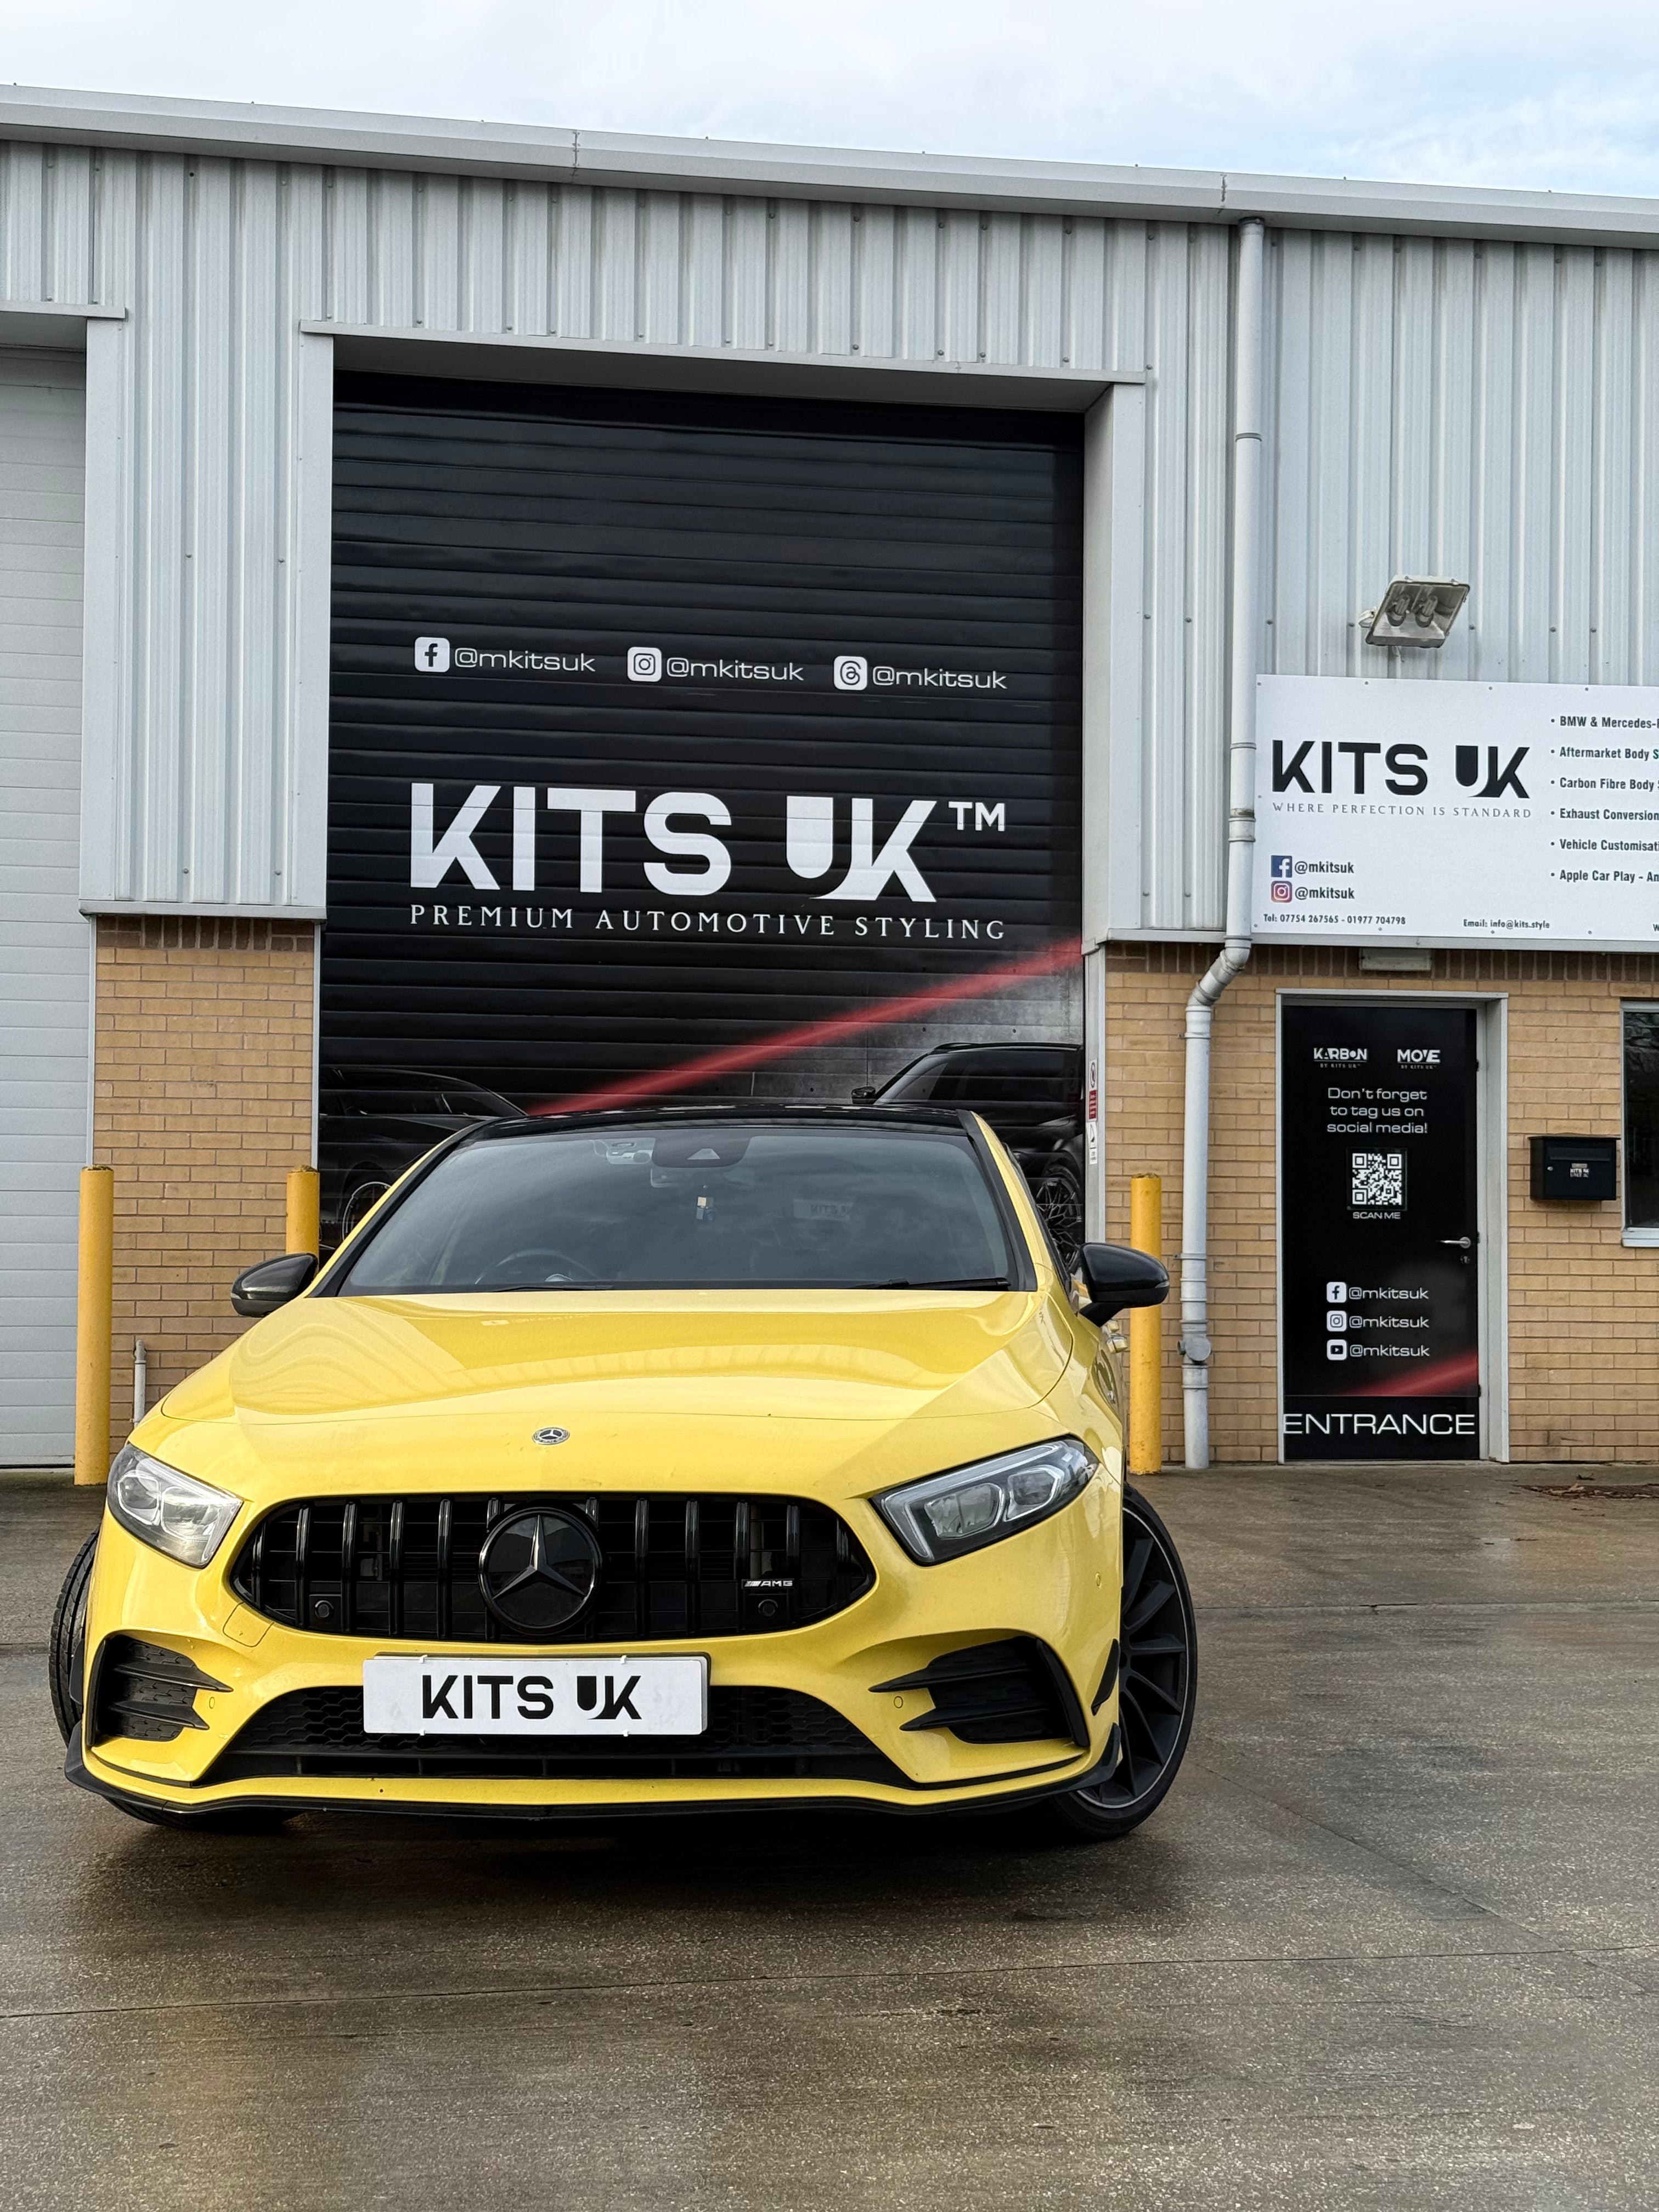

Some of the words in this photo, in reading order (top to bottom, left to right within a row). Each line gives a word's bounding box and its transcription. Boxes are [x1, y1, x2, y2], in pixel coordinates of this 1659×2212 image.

[454, 647, 596, 672] @mkitsuk
[667, 657, 804, 681] @mkitsuk
[872, 666, 1007, 689] @mkitsuk
[1560, 715, 1587, 727] BMW
[1590, 716, 1598, 727] &
[1559, 746, 1621, 759] Aftermarket
[1624, 748, 1649, 761] Body
[1272, 740, 1428, 796] KITS
[1455, 745, 1530, 799] UK
[1560, 777, 1596, 789] Carbon
[1600, 778, 1626, 789] Fibre
[1629, 779, 1654, 792] Body
[1272, 802, 1324, 814] WHERE
[1332, 803, 1425, 816] PERFECTION
[1432, 806, 1446, 816] IS
[1452, 806, 1531, 819] STANDARD
[1560, 808, 1600, 819] Exhaust
[410, 782, 732, 896] KITS
[1559, 838, 1597, 850] Vehicle
[1294, 861, 1355, 875] @mkitsuk
[1559, 870, 1588, 883] Apple
[1592, 870, 1610, 881] Car
[1613, 871, 1635, 884] Play
[1295, 887, 1355, 901] @mkitsuk
[410, 904, 573, 929] PREMIUM
[595, 909, 834, 936] AUTOMOTIVE
[855, 916, 1005, 940] STYLING
[1280, 914, 1305, 923] 07754
[1347, 916, 1373, 924] 01977
[1375, 916, 1406, 924] 704798
[1463, 919, 1488, 928] Email:
[1313, 1047, 1367, 1060] KARBON
[1397, 1049, 1441, 1063] MOVE
[1376, 1087, 1428, 1103] forget
[1329, 1105, 1347, 1116] to
[1351, 1105, 1379, 1119] tag
[1381, 1107, 1401, 1117] us
[1404, 1107, 1424, 1117] on
[1327, 1121, 1373, 1133] social
[1375, 1122, 1427, 1134] media!
[1352, 1211, 1383, 1220] SCAN
[1348, 1286, 1429, 1300] @mkitsuk
[1349, 1316, 1430, 1328] @mkitsuk
[1350, 1344, 1430, 1357] @mkitsuk
[1284, 1413, 1476, 1435] ENTRANCE
[422, 1675, 554, 1719] KITS
[576, 1675, 642, 1720] UK
